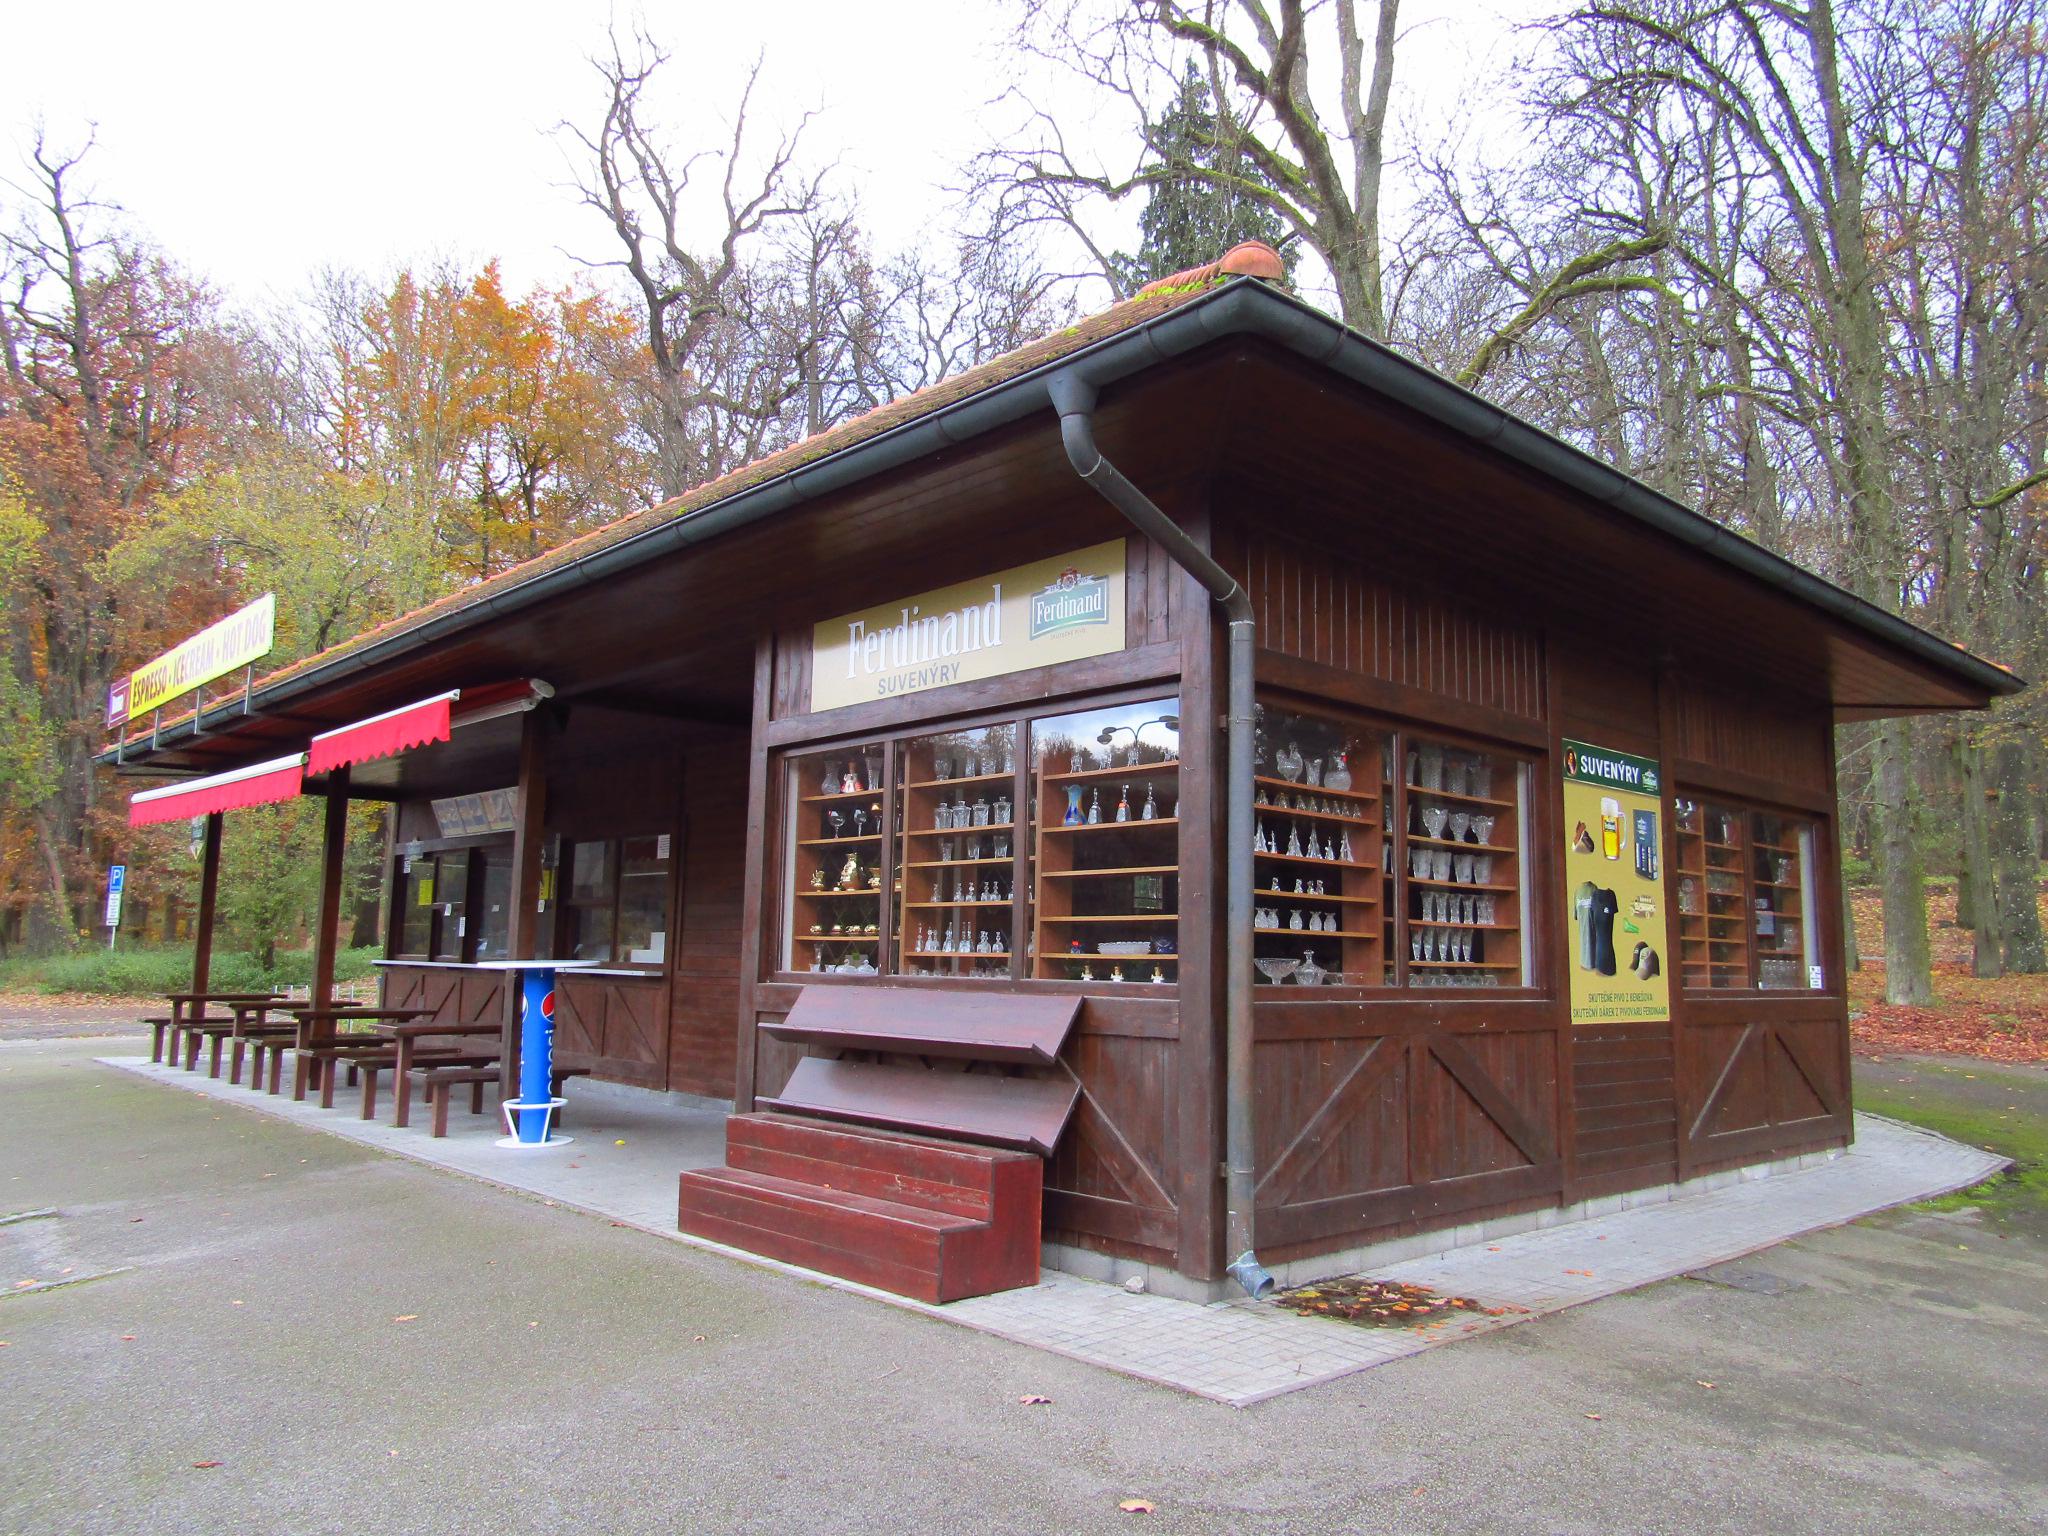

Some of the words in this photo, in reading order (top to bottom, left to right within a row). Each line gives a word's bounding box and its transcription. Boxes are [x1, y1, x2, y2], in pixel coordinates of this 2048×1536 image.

[1036, 587, 1102, 625] Ferdinand
[846, 583, 1003, 681] Ferdinand
[132, 664, 167, 708] ESPRESSO
[173, 637, 214, 689] ICECREAM
[223, 624, 243, 663] HOT
[244, 608, 268, 653] DOG
[877, 661, 961, 696] SUVENÝRY
[1580, 755, 1640, 785] SUVENÝRY
[112, 868, 122, 885] P
